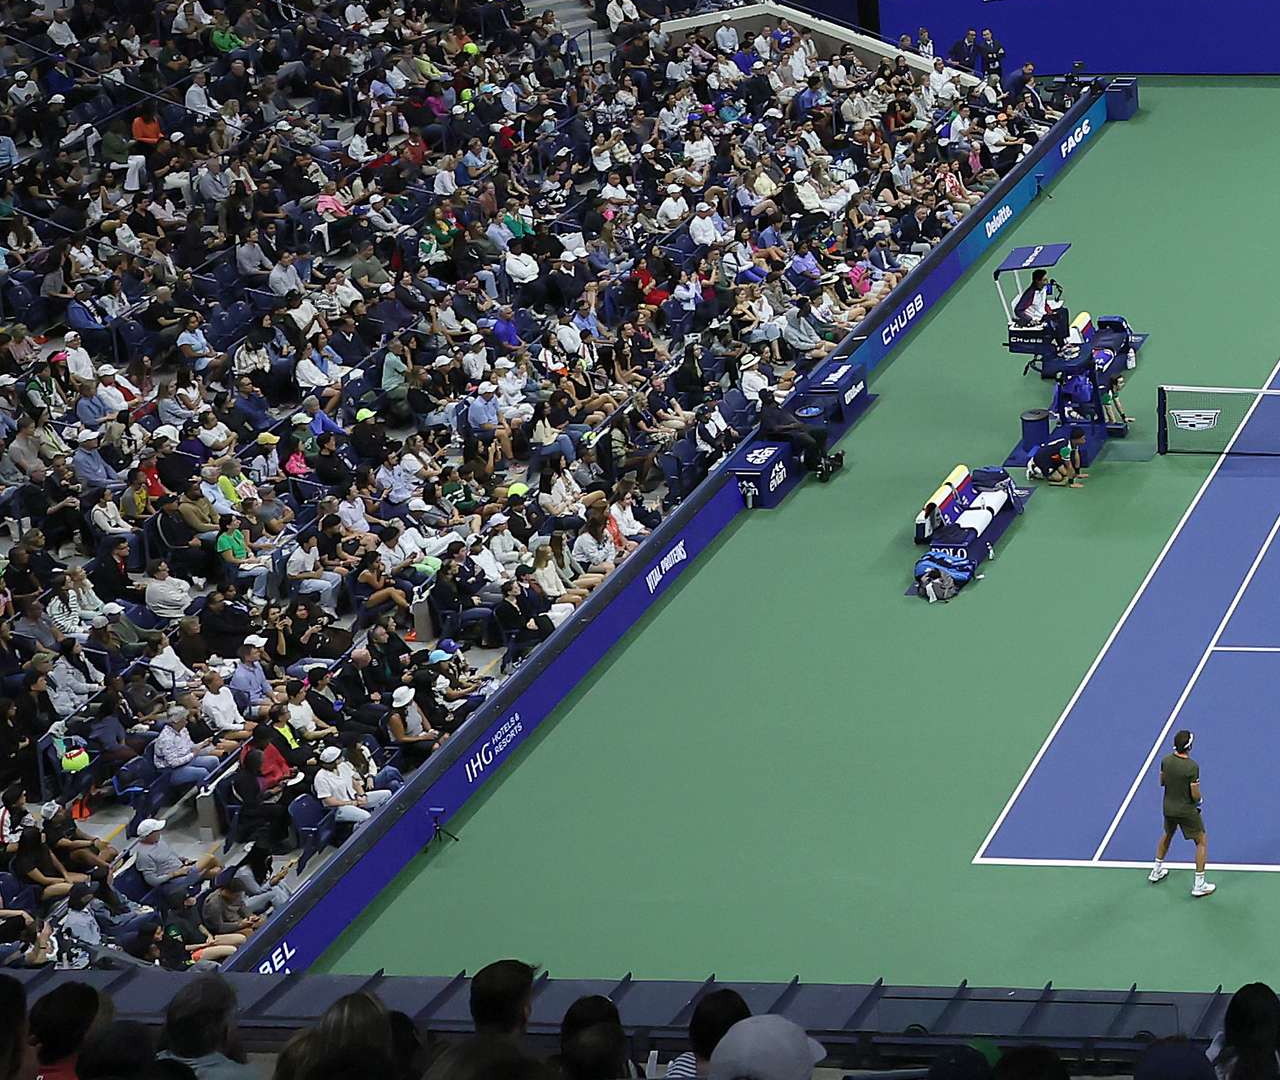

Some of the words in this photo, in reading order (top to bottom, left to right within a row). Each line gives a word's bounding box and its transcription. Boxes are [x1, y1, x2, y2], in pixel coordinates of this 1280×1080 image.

[985, 203, 1013, 238] Deloitte.
[881, 292, 924, 345] CHUBB
[1010, 336, 1043, 344] CHUBB
[769, 467, 787, 492] evian
[645, 565, 663, 594] VITAL
[660, 539, 687, 575] PROTEINS
[931, 547, 968, 561] POLO
[491, 716, 515, 745] HOTELS
[494, 722, 522, 755] RESORTS
[465, 742, 494, 783] IHG
[259, 941, 296, 975] BEL
